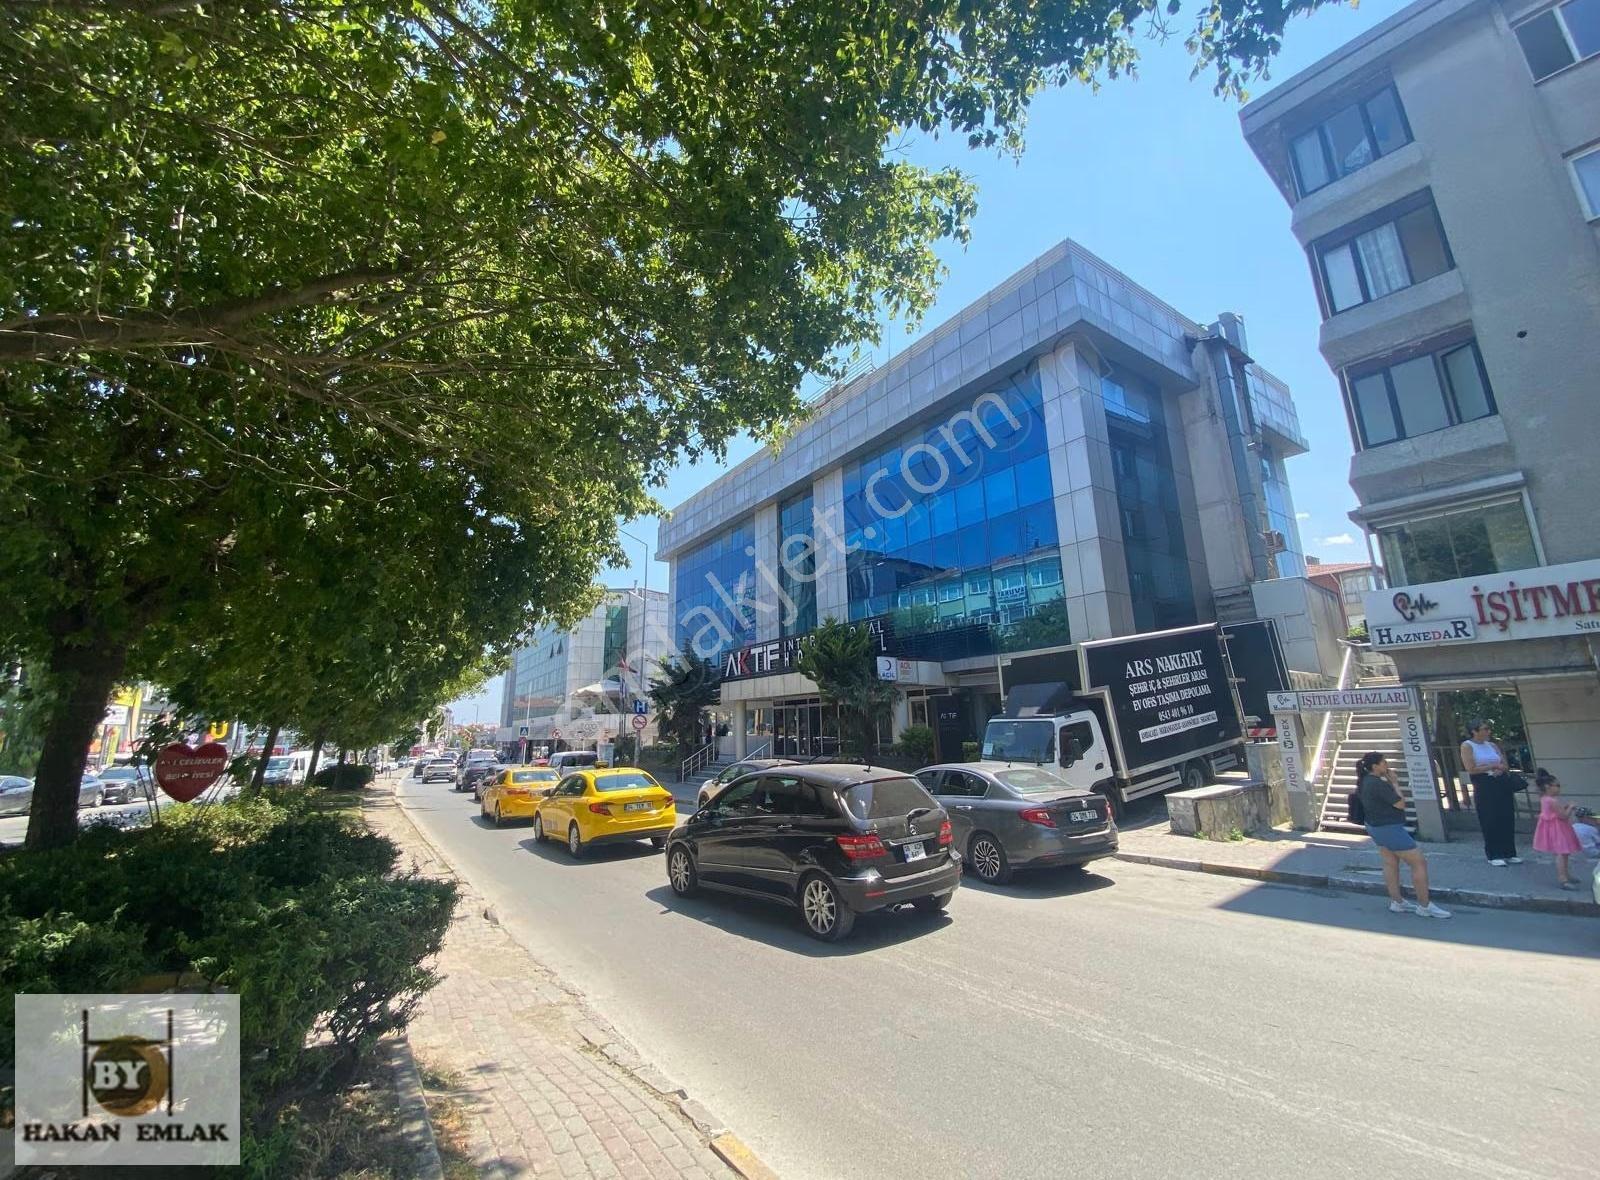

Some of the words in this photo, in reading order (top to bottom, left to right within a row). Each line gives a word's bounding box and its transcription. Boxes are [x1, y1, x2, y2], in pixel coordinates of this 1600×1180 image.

[1376, 620, 1471, 645] HAZNEDAR
[1126, 659, 1154, 678] ARS
[1133, 700, 1142, 711] EV
[1180, 684, 1212, 700] DEPOLAMA
[1301, 694, 1340, 707] İŞİTME
[1343, 690, 1408, 705] CİHAZLARI
[1407, 716, 1421, 752] oticon
